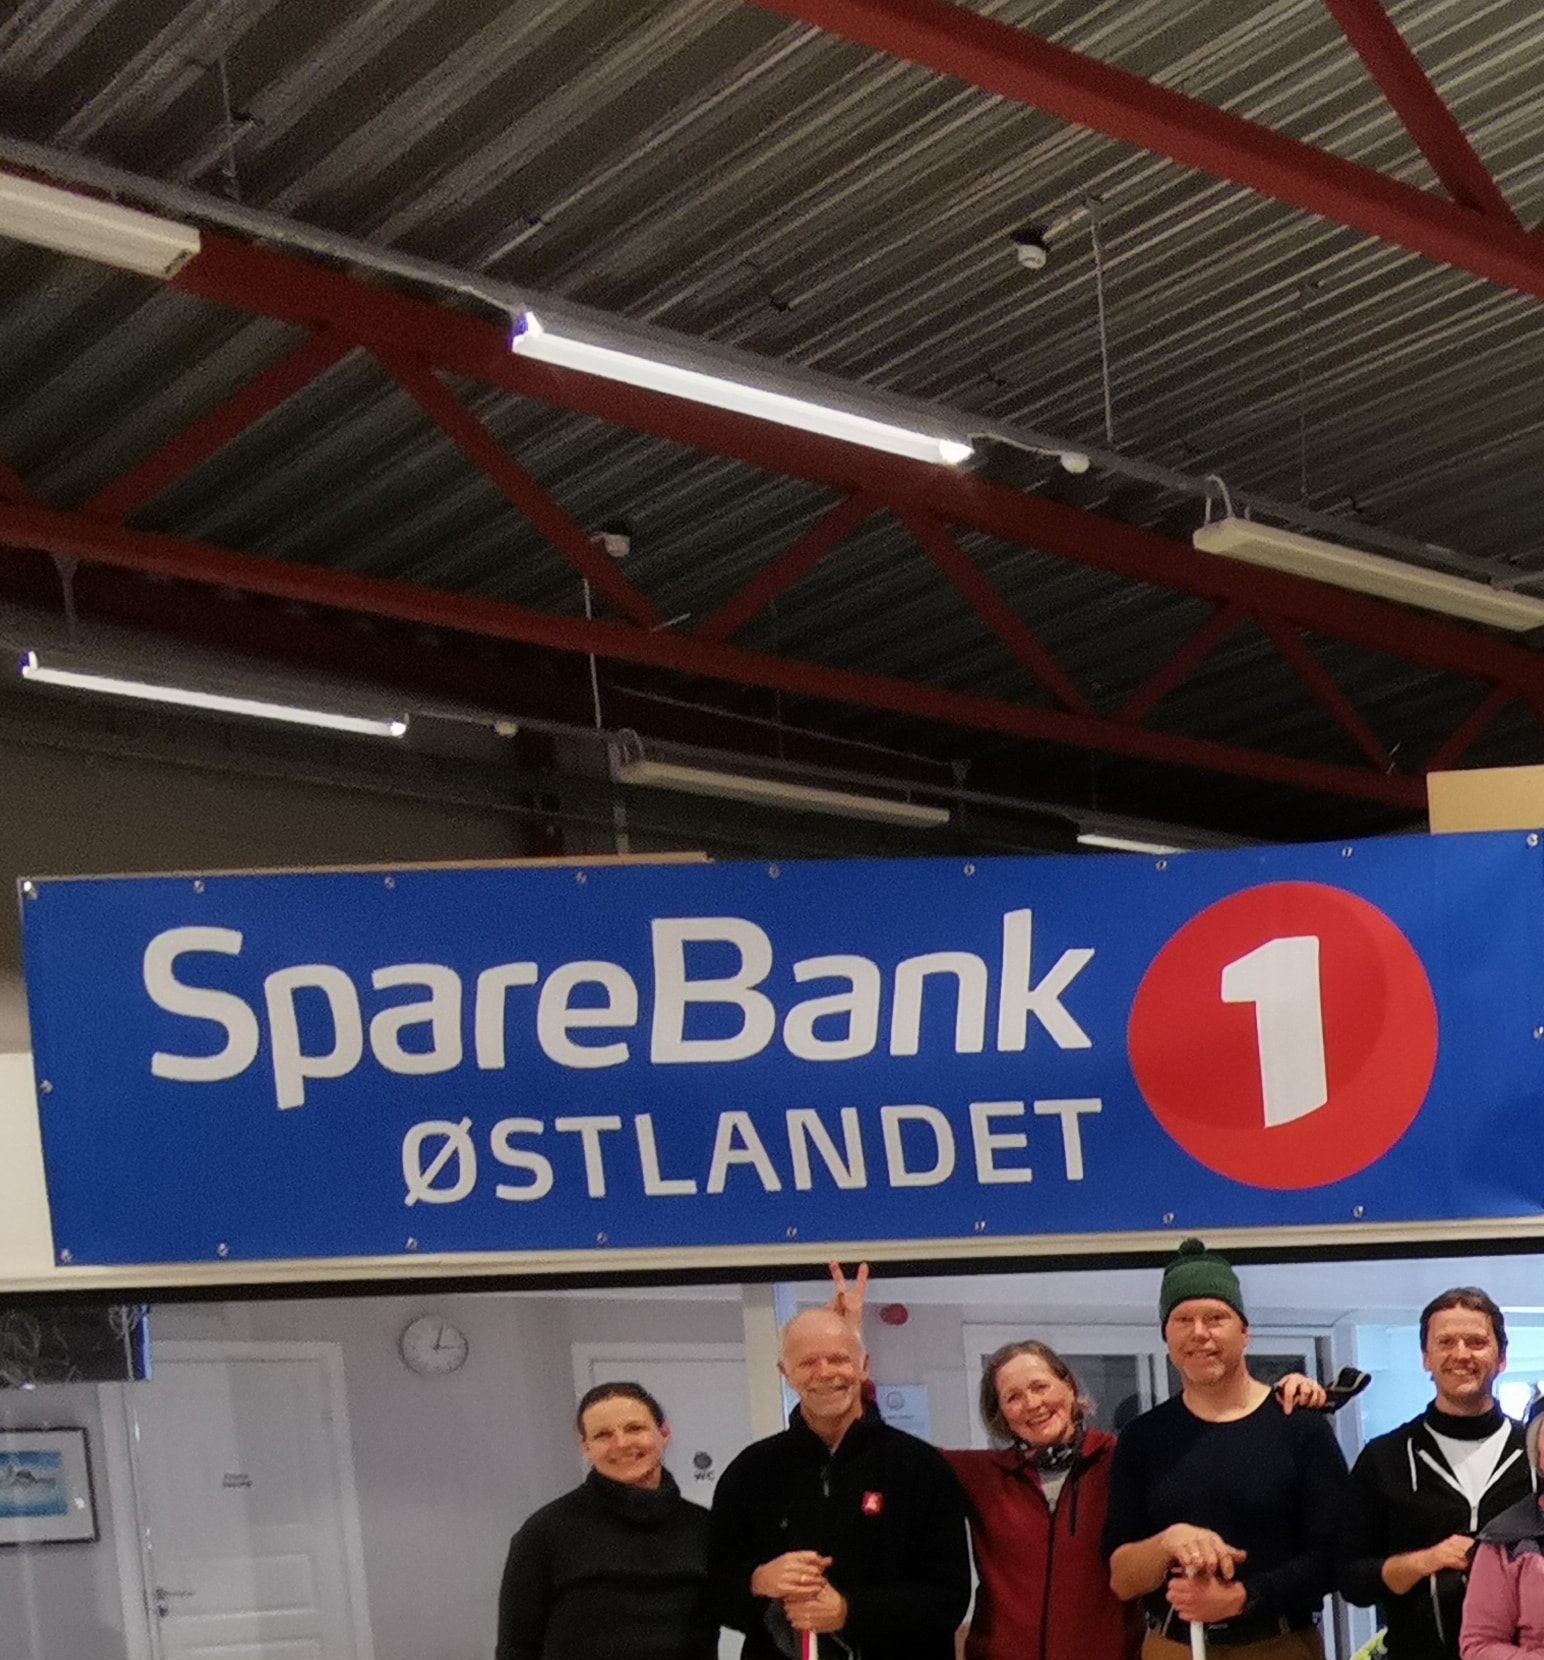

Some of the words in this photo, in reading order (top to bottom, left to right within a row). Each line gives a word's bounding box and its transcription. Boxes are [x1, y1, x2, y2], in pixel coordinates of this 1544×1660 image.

[141, 908, 1097, 1111] SpareBank
[1219, 935, 1328, 1128] 1
[402, 1097, 1104, 1207] ØSTLANDET
